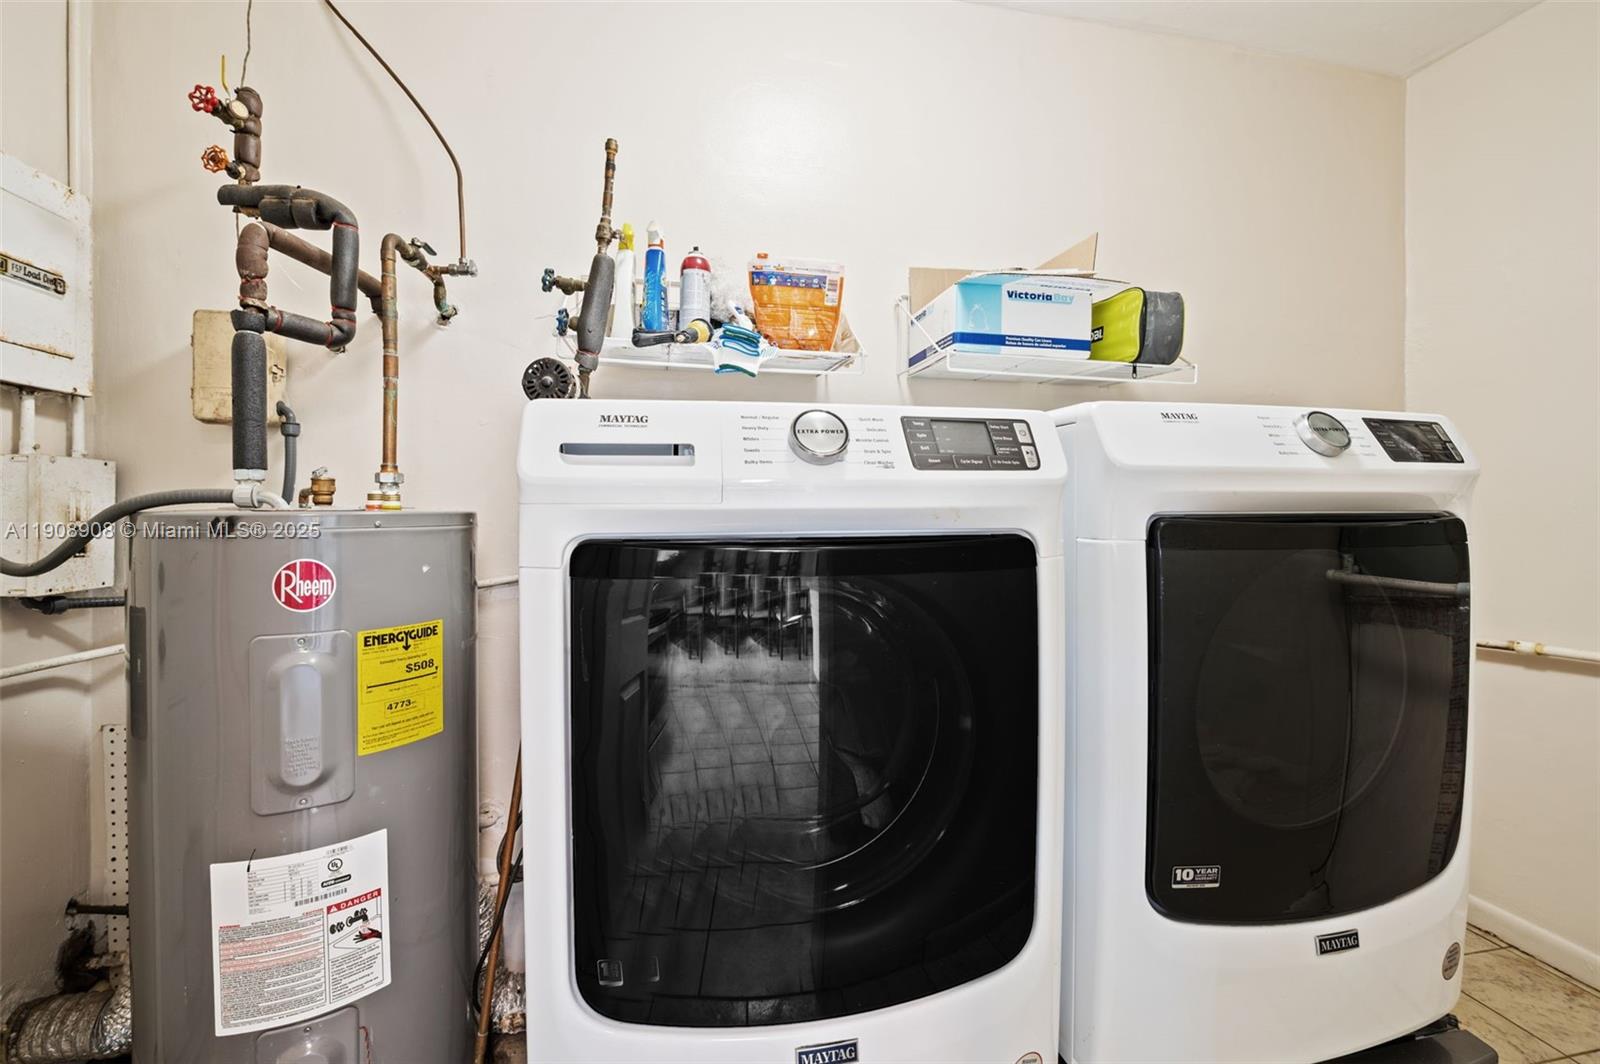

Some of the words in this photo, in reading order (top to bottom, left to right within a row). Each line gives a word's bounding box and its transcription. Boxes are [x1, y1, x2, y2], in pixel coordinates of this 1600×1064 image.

[24, 266, 42, 281] Load
[600, 414, 649, 423] MAYTAG
[1160, 412, 1198, 420] MAYTAG
[281, 561, 332, 604] Rheem
[364, 625, 439, 648] ENERGYGUIDE
[406, 658, 435, 673] $508
[387, 699, 412, 711] 4773
[1175, 868, 1194, 881] 10
[340, 890, 379, 909] DANGER
[1321, 935, 1358, 952] MAYTAG
[801, 1046, 856, 1064] MAYTAG
